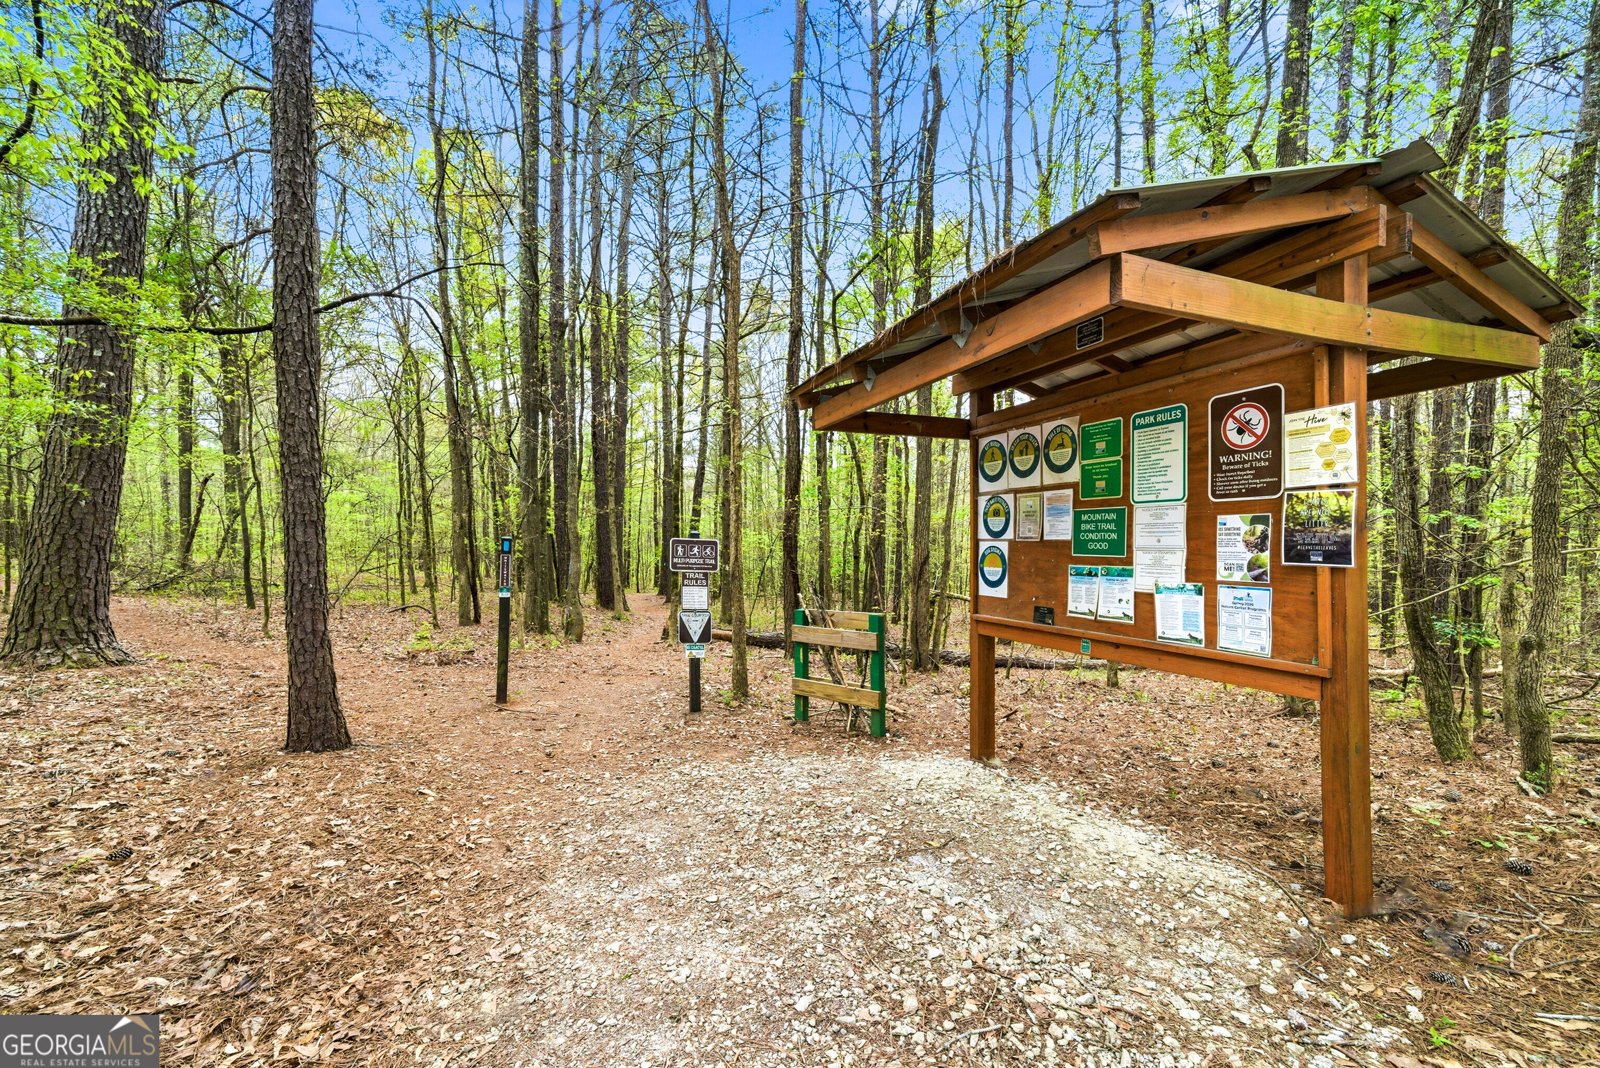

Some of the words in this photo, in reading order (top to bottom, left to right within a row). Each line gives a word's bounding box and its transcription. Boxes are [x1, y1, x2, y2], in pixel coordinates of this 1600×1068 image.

[1136, 415, 1154, 426] PARK
[1156, 410, 1182, 422] RULES
[1219, 450, 1272, 464] WARNING!
